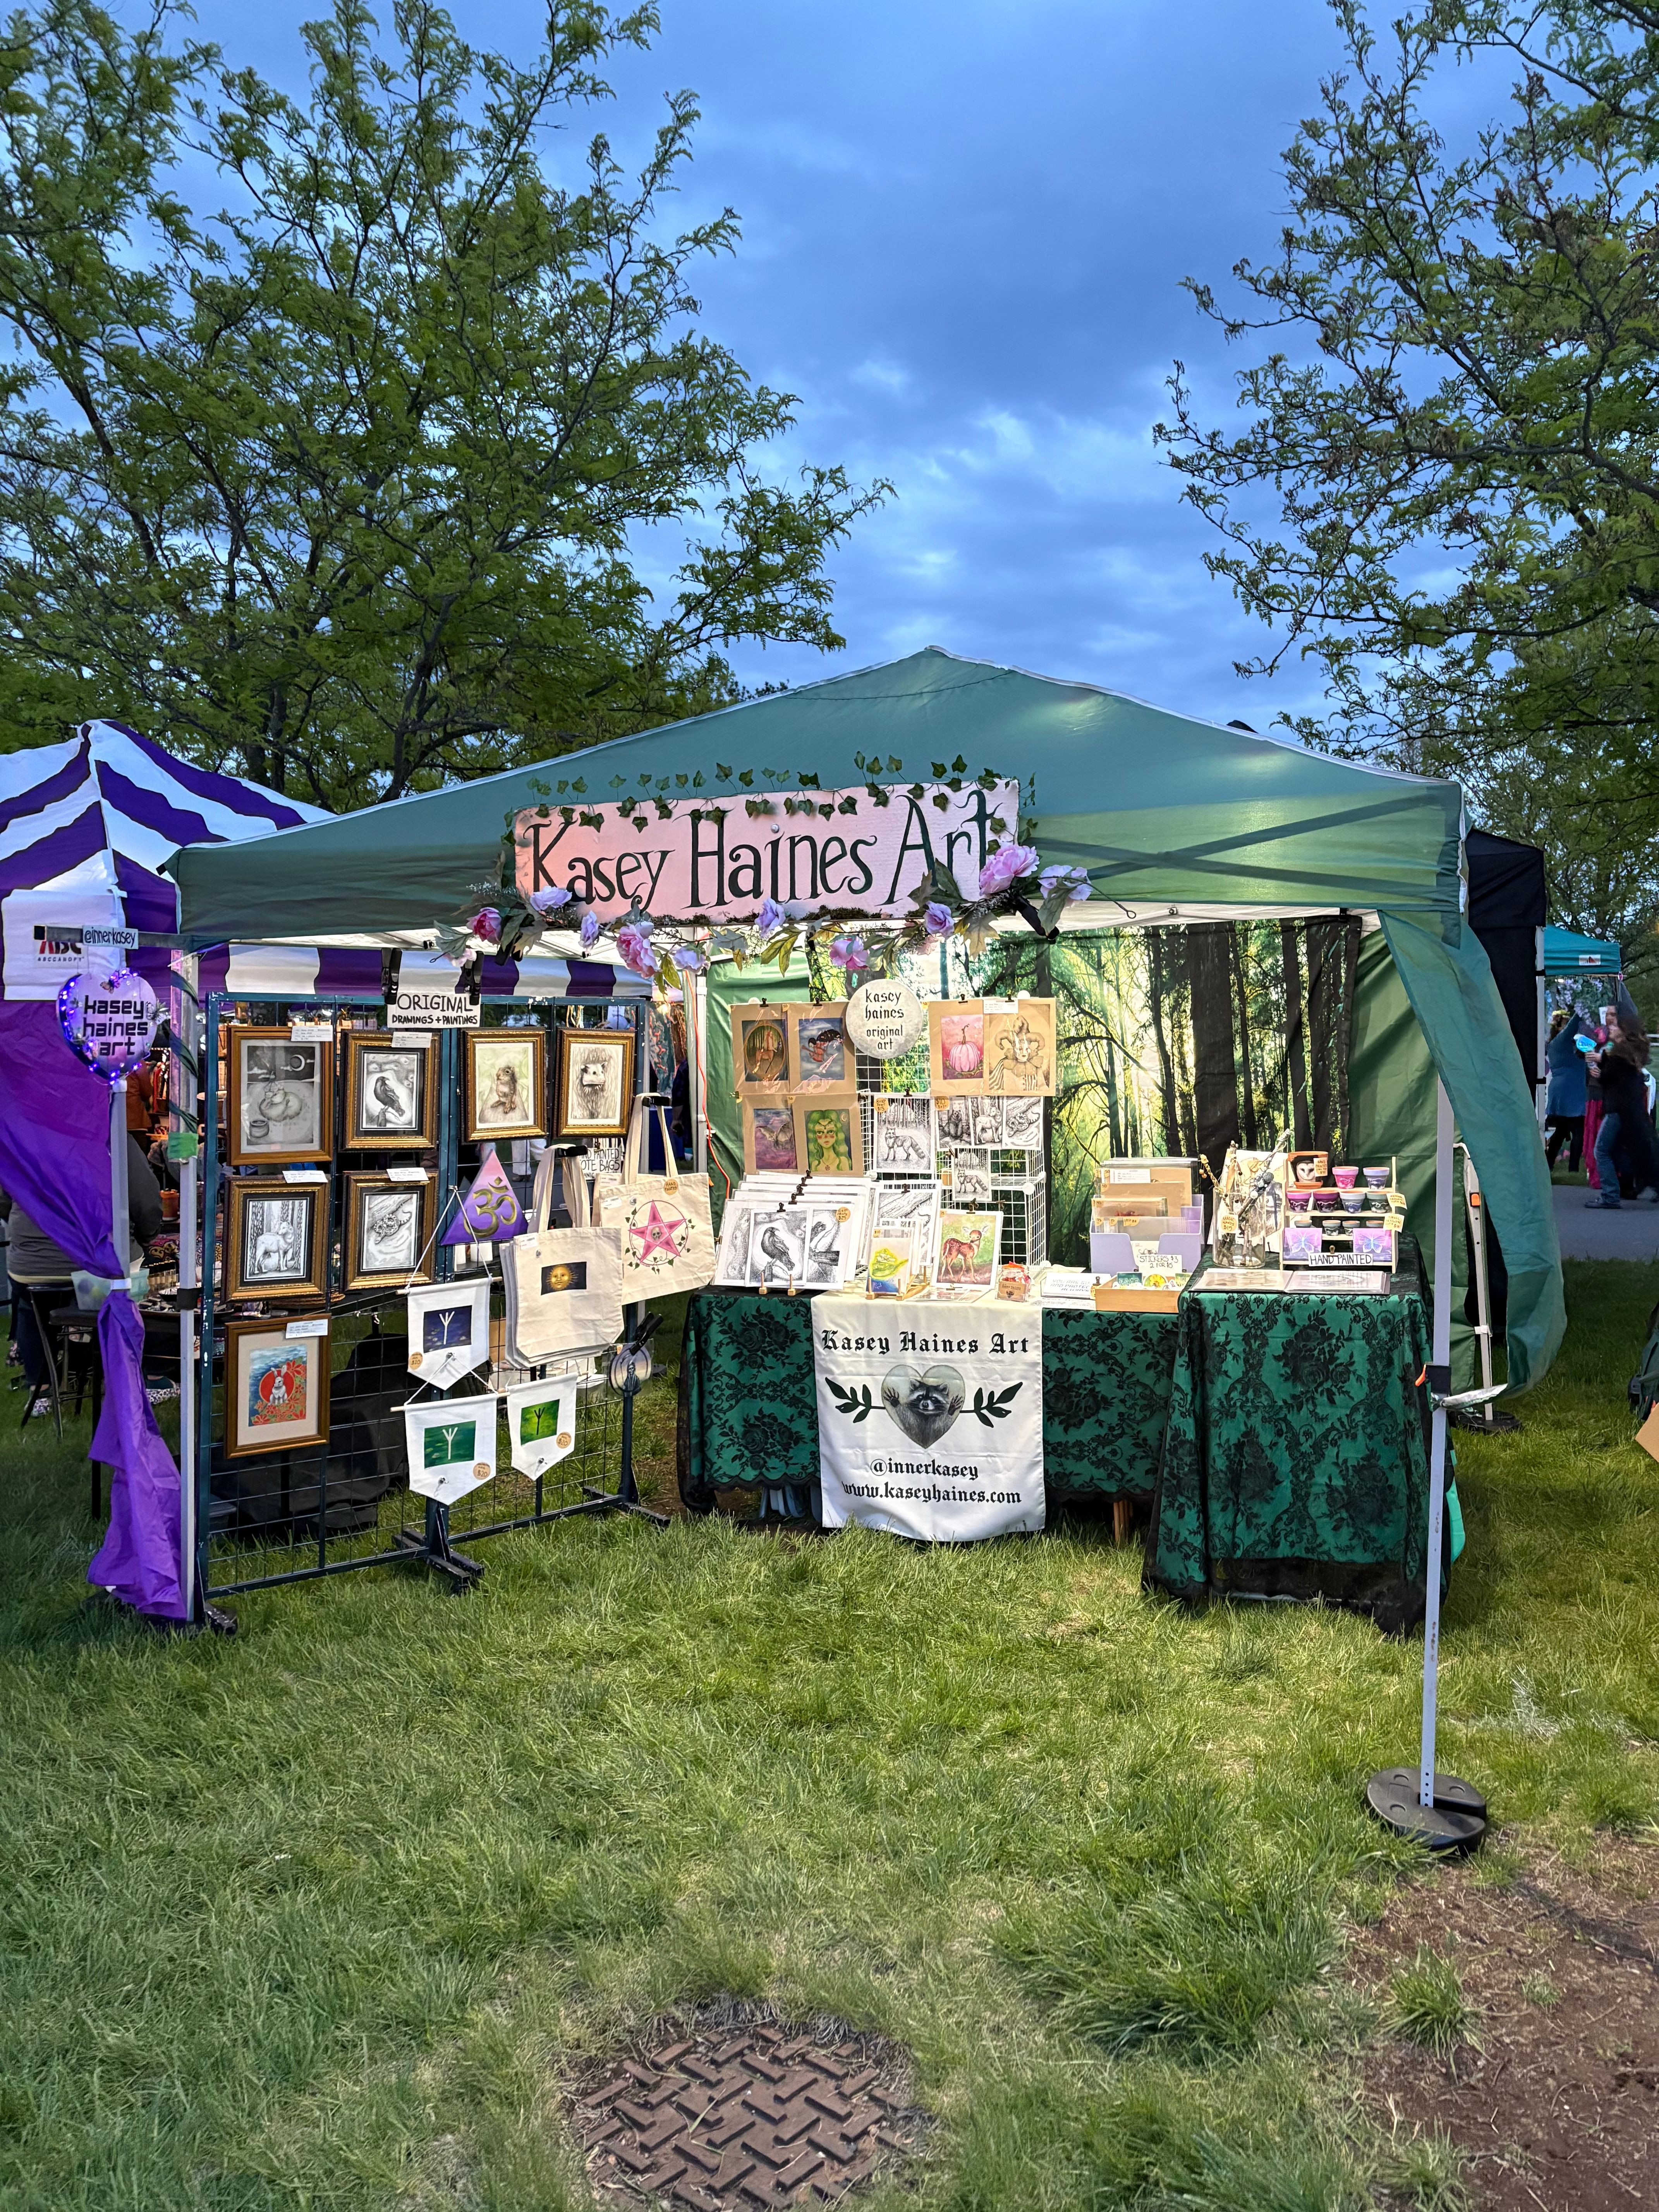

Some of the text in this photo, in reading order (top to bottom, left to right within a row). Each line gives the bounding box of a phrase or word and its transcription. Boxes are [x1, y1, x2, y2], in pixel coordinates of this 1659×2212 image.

[523, 790, 1003, 911] Kasey Haines Art
[84, 927, 136, 948] @innerkasey
[397, 993, 473, 1013] ORIGINAL
[865, 988, 902, 1006] kasey
[83, 995, 144, 1020] kasey
[865, 1004, 904, 1021] haines
[83, 1017, 148, 1037] haines
[392, 1014, 434, 1024] DRAWINGS
[443, 1015, 478, 1025] PAINTINGS
[866, 1024, 903, 1040] original
[99, 1036, 136, 1056] art
[878, 1037, 894, 1050] art
[599, 1159, 620, 1172] BAGS
[1171, 1255, 1179, 1263] $3
[1310, 1254, 1372, 1265] HAND PAINTED
[821, 1329, 1029, 1355] Kasey Haines Art
[558, 1438, 568, 1446] $20
[870, 1458, 979, 1480] @innerkasey
[842, 1480, 1022, 1503] www.kaseyhaines.com
